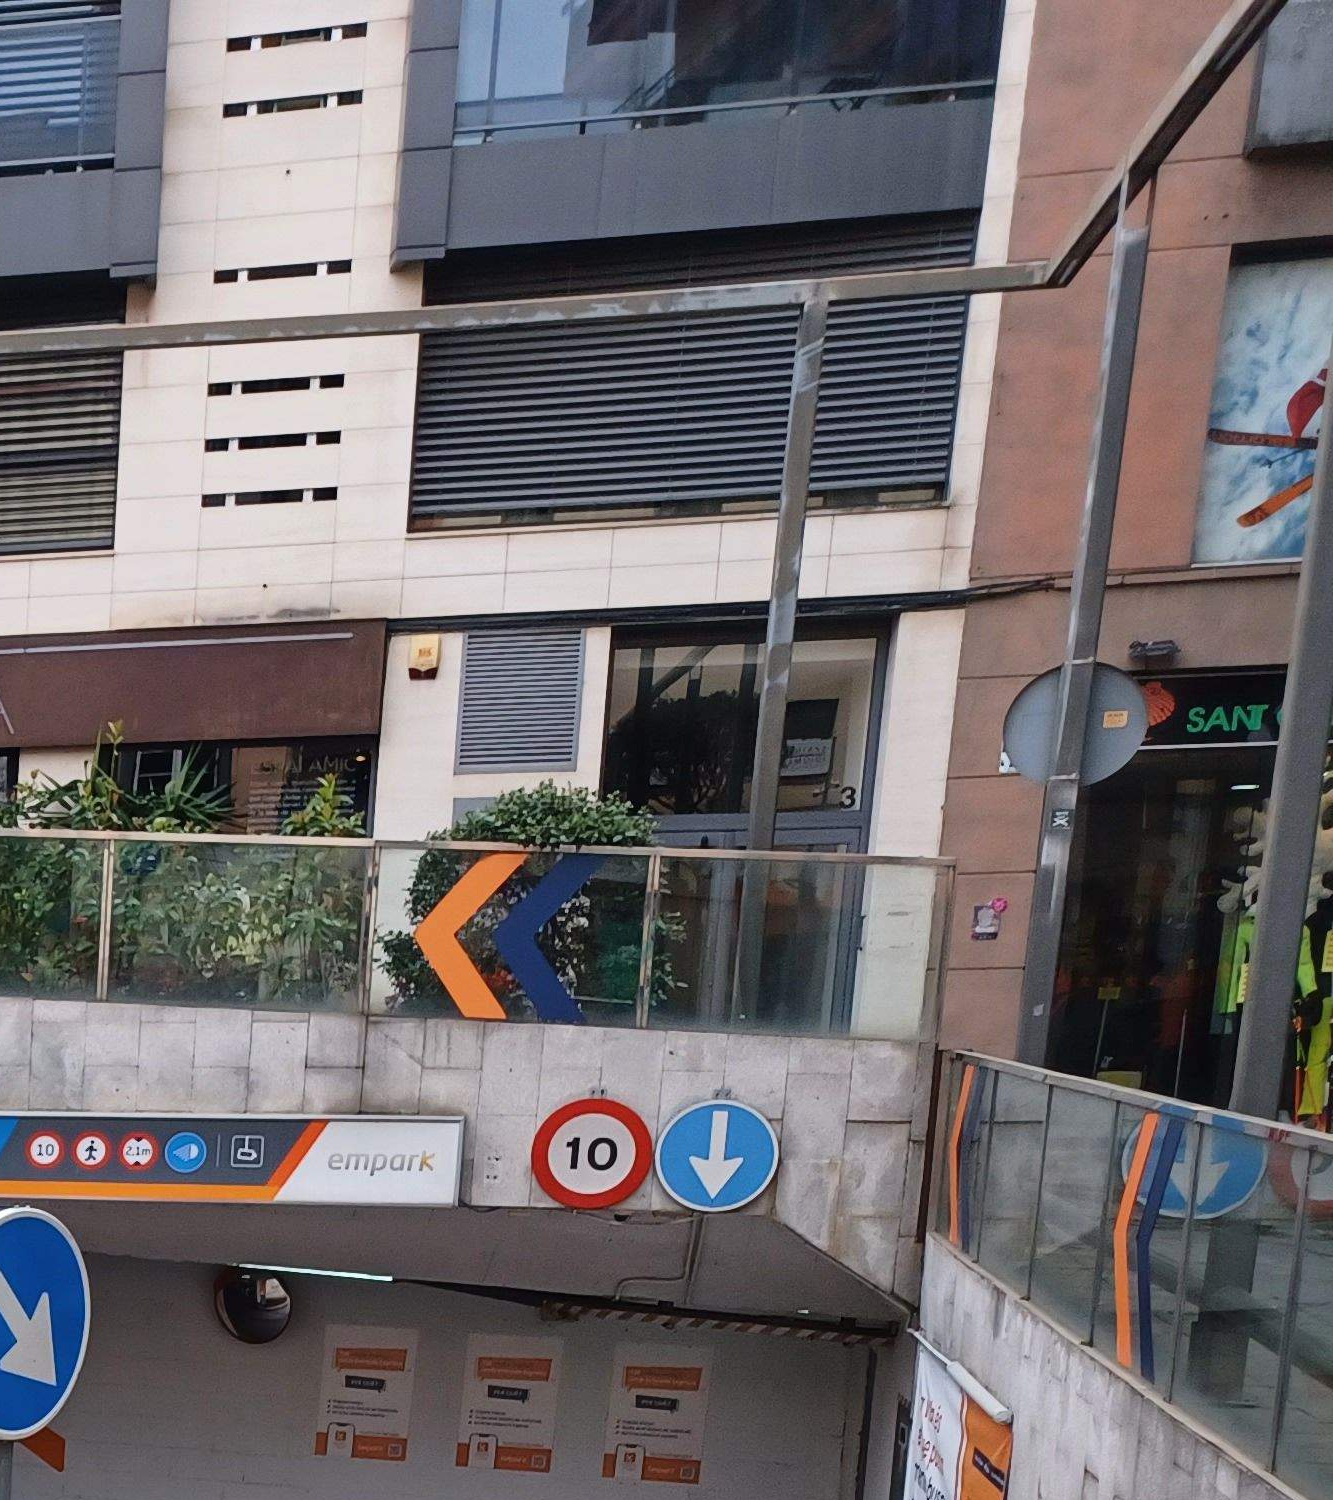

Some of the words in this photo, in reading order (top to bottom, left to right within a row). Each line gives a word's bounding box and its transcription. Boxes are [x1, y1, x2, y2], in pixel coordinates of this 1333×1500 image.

[36, 1143, 55, 1157] 10
[327, 1150, 436, 1177] empark
[565, 1137, 618, 1171] 10
